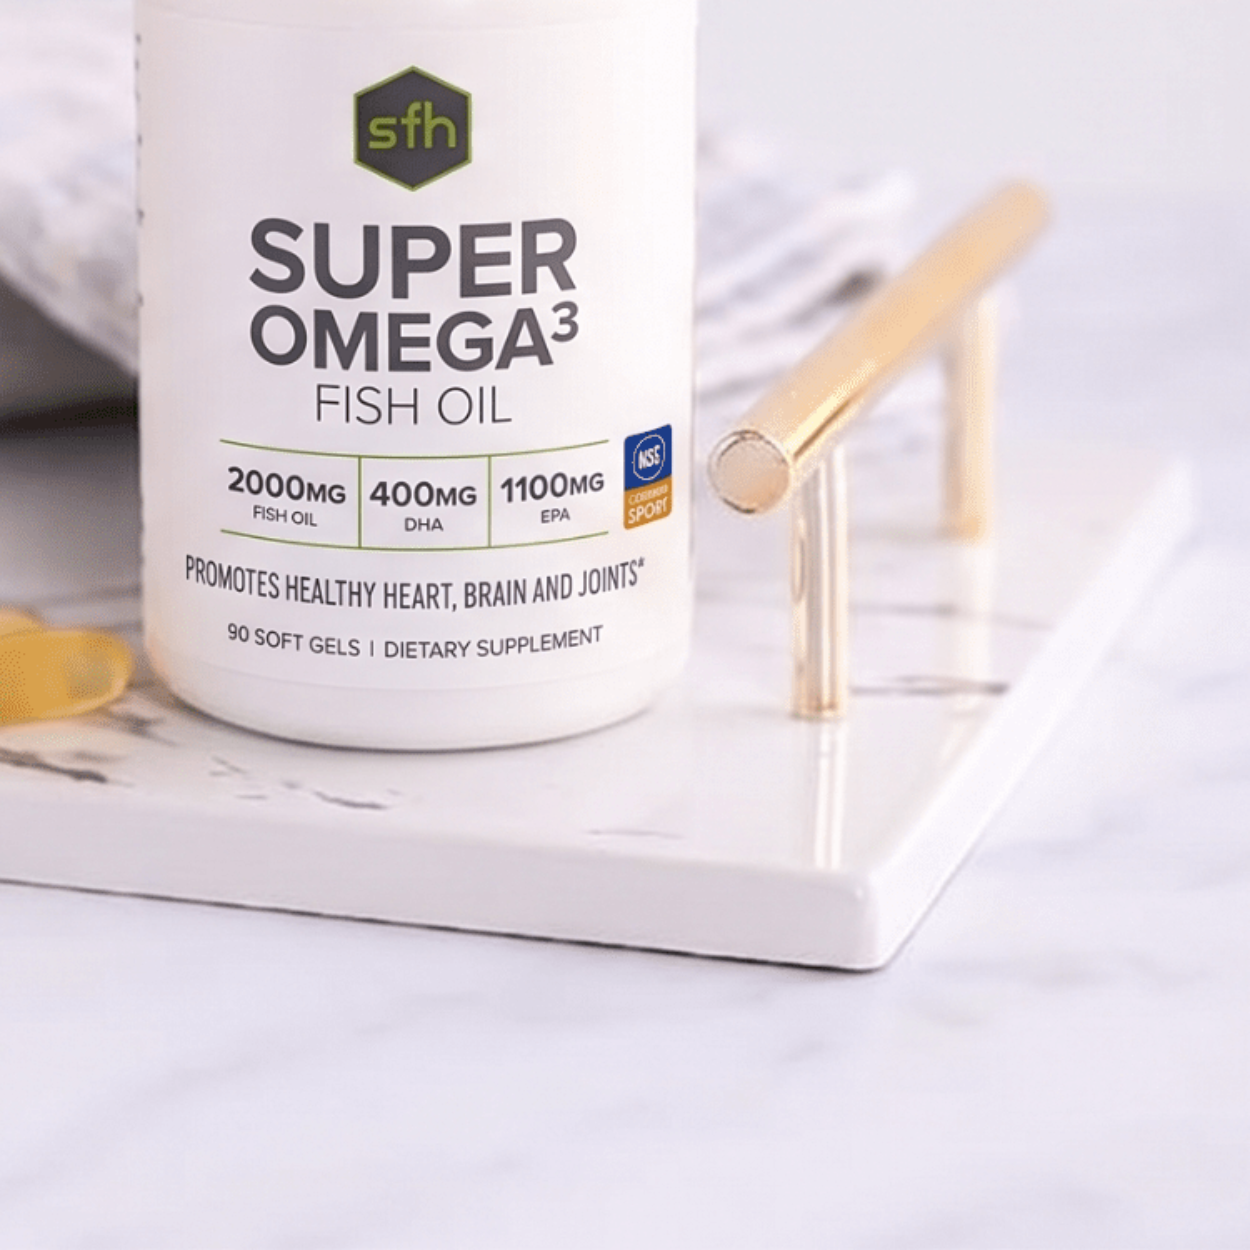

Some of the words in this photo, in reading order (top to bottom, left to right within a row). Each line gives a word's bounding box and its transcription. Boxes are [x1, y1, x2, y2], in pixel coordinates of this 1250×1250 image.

[368, 100, 457, 149] sfh
[248, 217, 578, 299] SUPER
[316, 383, 418, 425] FISH
[437, 385, 513, 425] OIL
[227, 465, 347, 505] 2000MG
[369, 480, 478, 508] 400MG
[500, 471, 605, 504] 1100MG
[252, 504, 289, 524] FISH
[290, 509, 318, 528] OIL
[404, 517, 444, 532] DHA
[540, 507, 571, 524] EPA
[627, 496, 669, 524] SPORT
[185, 554, 280, 600] PROMOTES
[285, 575, 377, 609] HEALTHY
[383, 582, 458, 613] HEART,
[464, 578, 527, 609] BRAIN
[532, 572, 573, 604] AND
[227, 622, 250, 644] 90
[254, 627, 304, 652] SOFT
[308, 635, 361, 657] GELS
[384, 640, 471, 659] DIETARY
[476, 624, 604, 658] SUPPLEMENT
